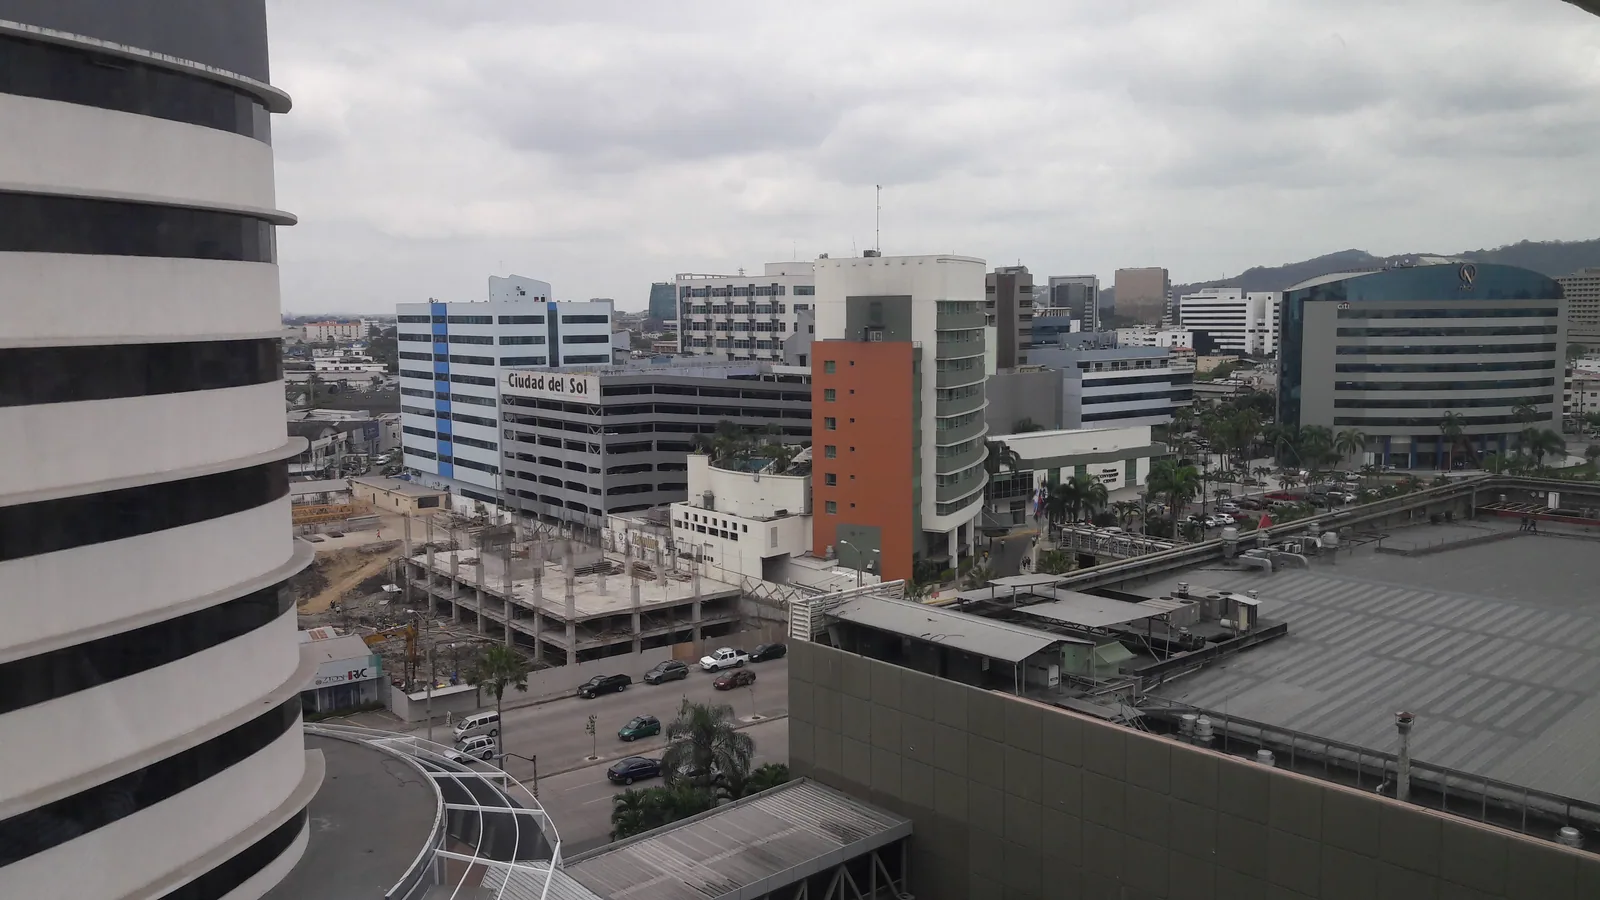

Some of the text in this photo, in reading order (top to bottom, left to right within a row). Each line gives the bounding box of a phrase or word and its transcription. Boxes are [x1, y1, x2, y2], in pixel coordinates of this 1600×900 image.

[508, 373, 587, 394] Ciudad del Sol
